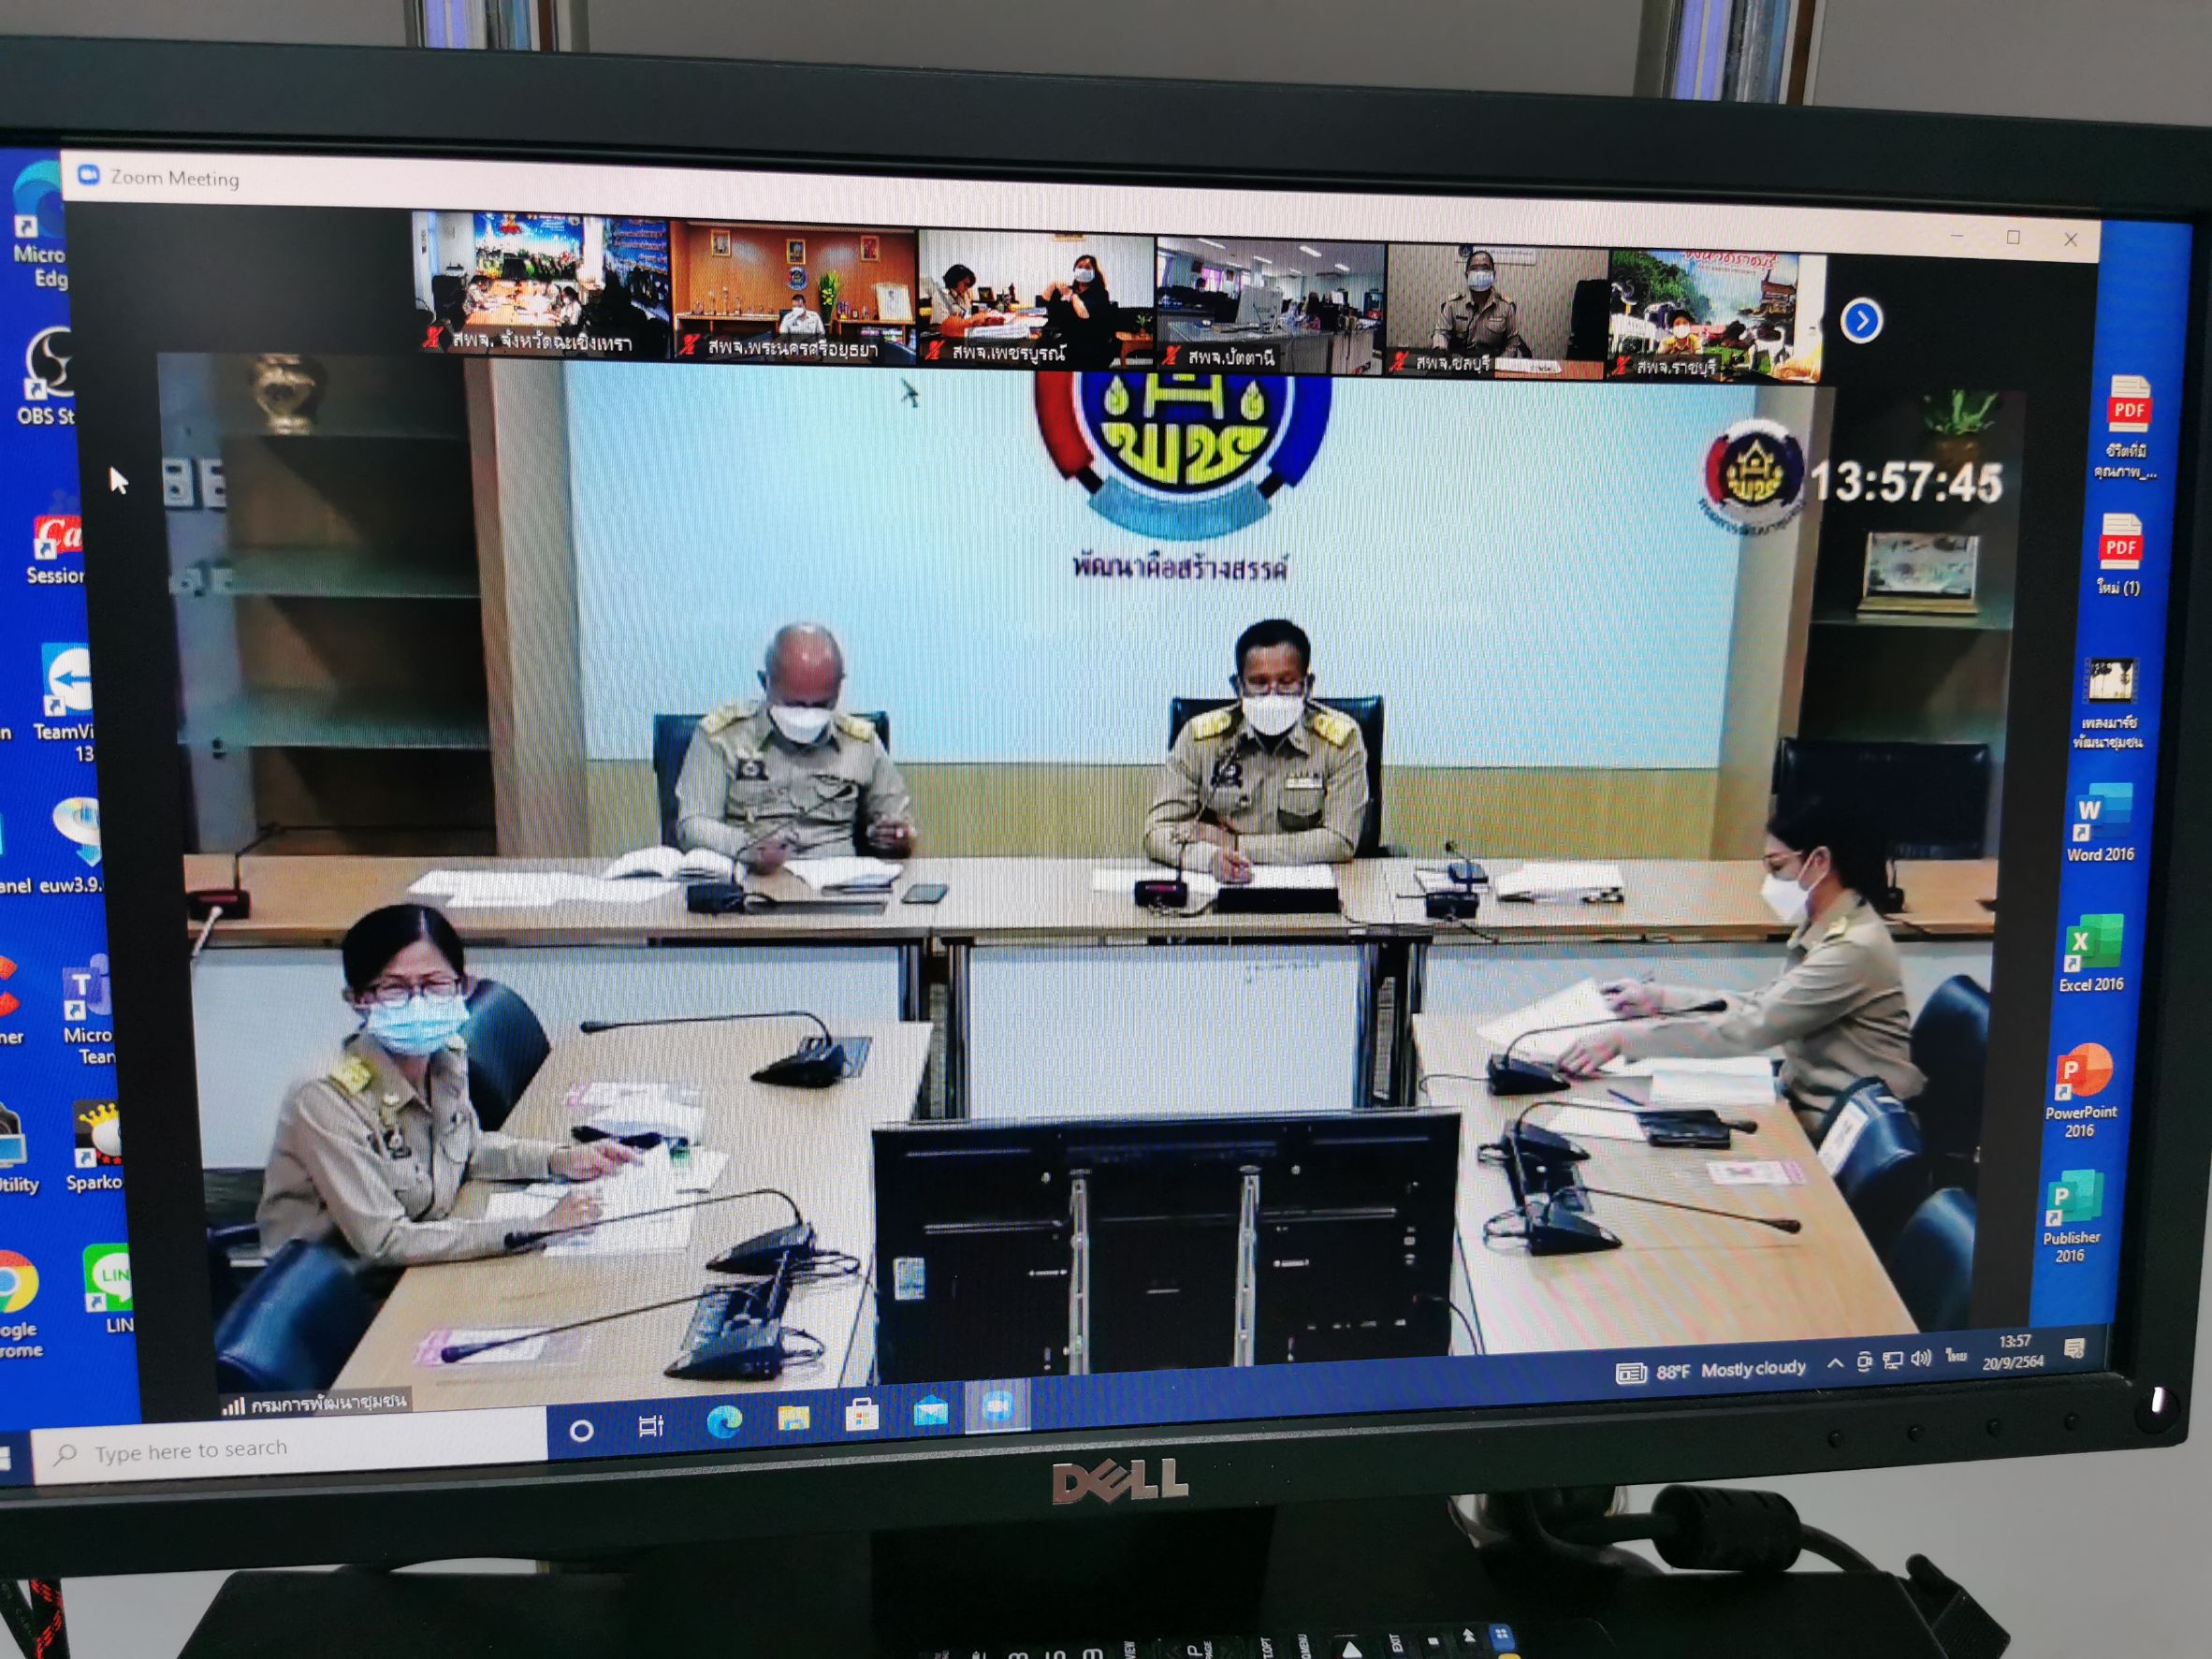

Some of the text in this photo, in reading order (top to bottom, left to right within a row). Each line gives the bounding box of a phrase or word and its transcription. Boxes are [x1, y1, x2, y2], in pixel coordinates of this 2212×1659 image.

[110, 168, 240, 192] Zoom Meeting
[14, 244, 65, 263] Micro
[35, 268, 69, 291] Edg
[453, 333, 494, 348] สพจ.
[708, 338, 879, 360] สพจ.พระนครศรีอยุธยา
[953, 343, 1068, 366] สพจ.เพชรบูรณ์
[1188, 347, 1276, 368] สพจ.ปัตตานี
[1417, 355, 1491, 374] สพจ.ชลบุรี
[1637, 357, 1717, 379] สพจ.ราชบุรี
[18, 407, 76, 425] OBS St
[2115, 402, 2145, 417] PDF
[1811, 459, 2004, 503] 13:57:45
[2106, 540, 2137, 555] PDF
[1072, 548, 1291, 581] พัฒนาคือสร้างสรรค์
[2097, 577, 2141, 597] ใหม่ (1)
[33, 722, 94, 740] TeamVi
[2074, 734, 2145, 752] พัฒนาชุมชน
[76, 745, 94, 763] 13
[2067, 847, 2135, 862] Word 2016
[2059, 978, 2124, 992] Excel 2016
[65, 1027, 112, 1043] Micro
[2045, 1105, 2117, 1120] PowerPoint
[2065, 1124, 2095, 1138] 2016
[66, 1174, 123, 1194] Sparko
[2044, 1231, 2101, 1245] Publisher
[2056, 1249, 2085, 1263] 2016
[107, 1317, 135, 1333] LIN
[2000, 1333, 2032, 1348] 13:57
[1656, 1359, 1806, 1381] 88°F Mostly cloudy
[1983, 1354, 2045, 1371] 20/9/2564
[252, 1393, 407, 1413] กรมการพัฒนาชุมชน
[95, 1439, 288, 1466] Type here to search
[1053, 1458, 1189, 1505] DELL
[1388, 1633, 1404, 1653] EXIT
